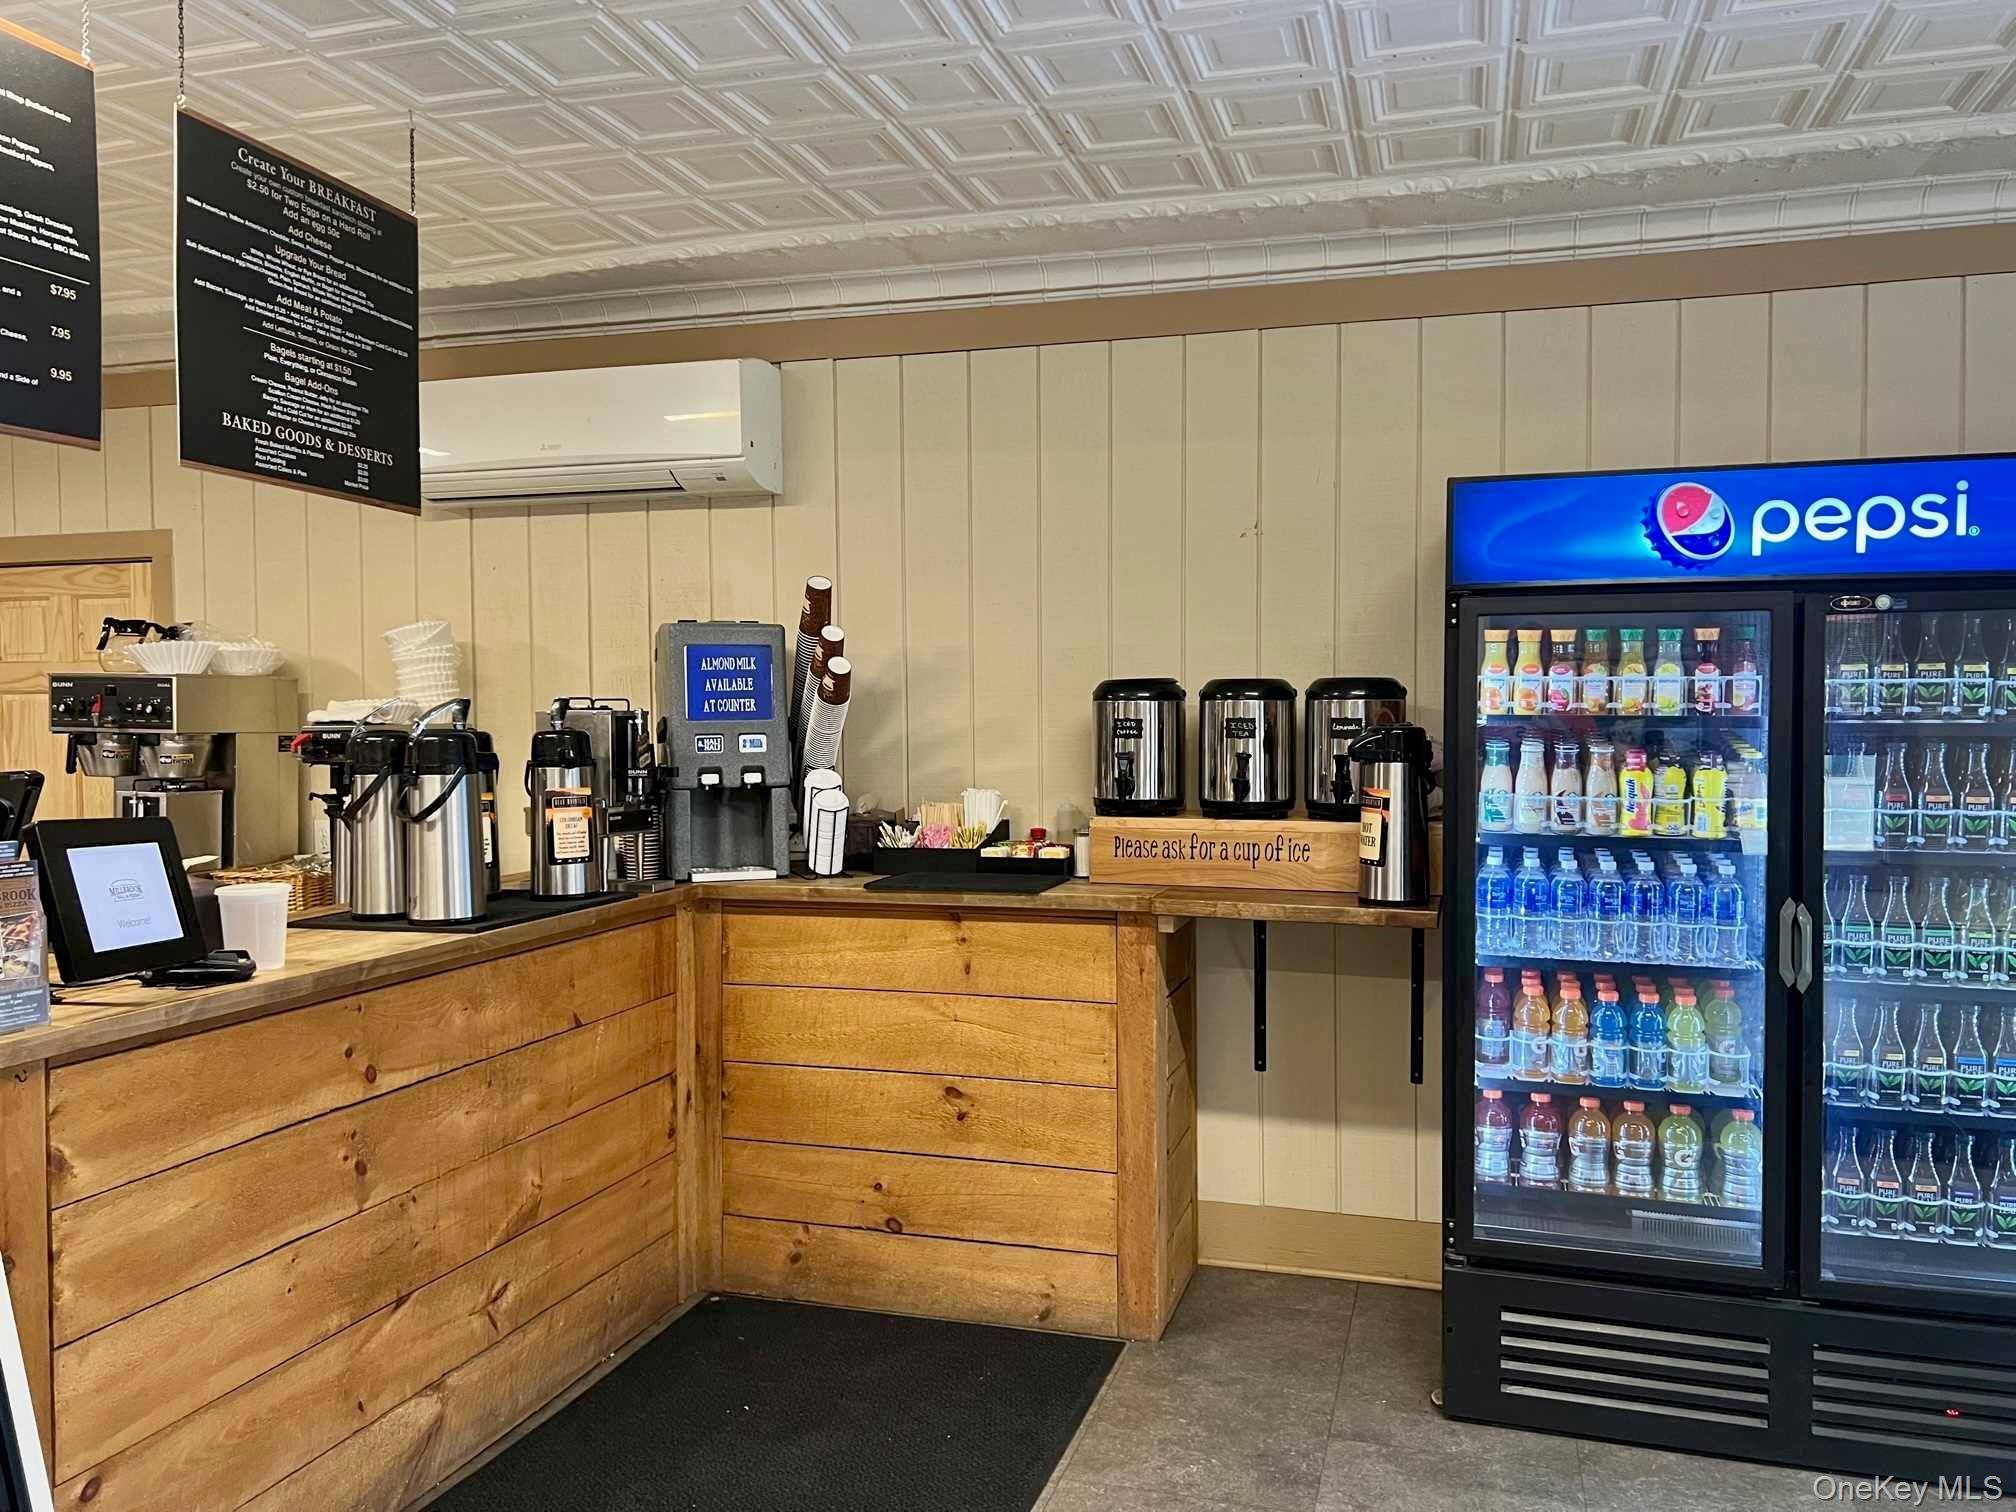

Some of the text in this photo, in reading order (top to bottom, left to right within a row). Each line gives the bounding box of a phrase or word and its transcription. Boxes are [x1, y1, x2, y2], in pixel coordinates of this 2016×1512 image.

[238, 147, 376, 220] Create Your BREAKFAST
[246, 178, 268, 195] $2.50
[271, 189, 281, 200] for
[284, 194, 299, 208] Two
[301, 202, 319, 217] Eggs
[321, 214, 330, 222] on
[339, 220, 355, 233] Hard
[357, 228, 370, 240] Roll
[282, 207, 298, 219] Add
[300, 215, 309, 224] an
[311, 221, 325, 233] egg
[288, 225, 331, 250] Add Cheese
[275, 245, 346, 280] Upgrade Your Bread
[50, 284, 76, 300] $7.95
[276, 294, 342, 324] Add Meat & Potato
[50, 326, 72, 340] 7.95
[270, 342, 296, 358] Bagels
[297, 353, 324, 368] starting
[15, 374, 30, 384] Side
[50, 368, 72, 382] 9.95
[284, 372, 306, 385] Bagel
[222, 412, 392, 465] BAKED GOODS & DESSERTS
[1752, 480, 1969, 556] pepsi
[701, 656, 756, 670] ALMOND MILK
[705, 678, 754, 692] AVAILABLE
[704, 698, 756, 712] AT COUNTER
[1114, 832, 1310, 868] Please ask for a cup of ice
[1848, 932, 1870, 940] PURE
[1888, 934, 1910, 943] PURE
[1928, 936, 1951, 944] PURE
[1960, 1064, 1984, 1072] PURE
[1998, 1066, 2016, 1074] PUR
[1917, 1192, 1936, 1200] PURE
